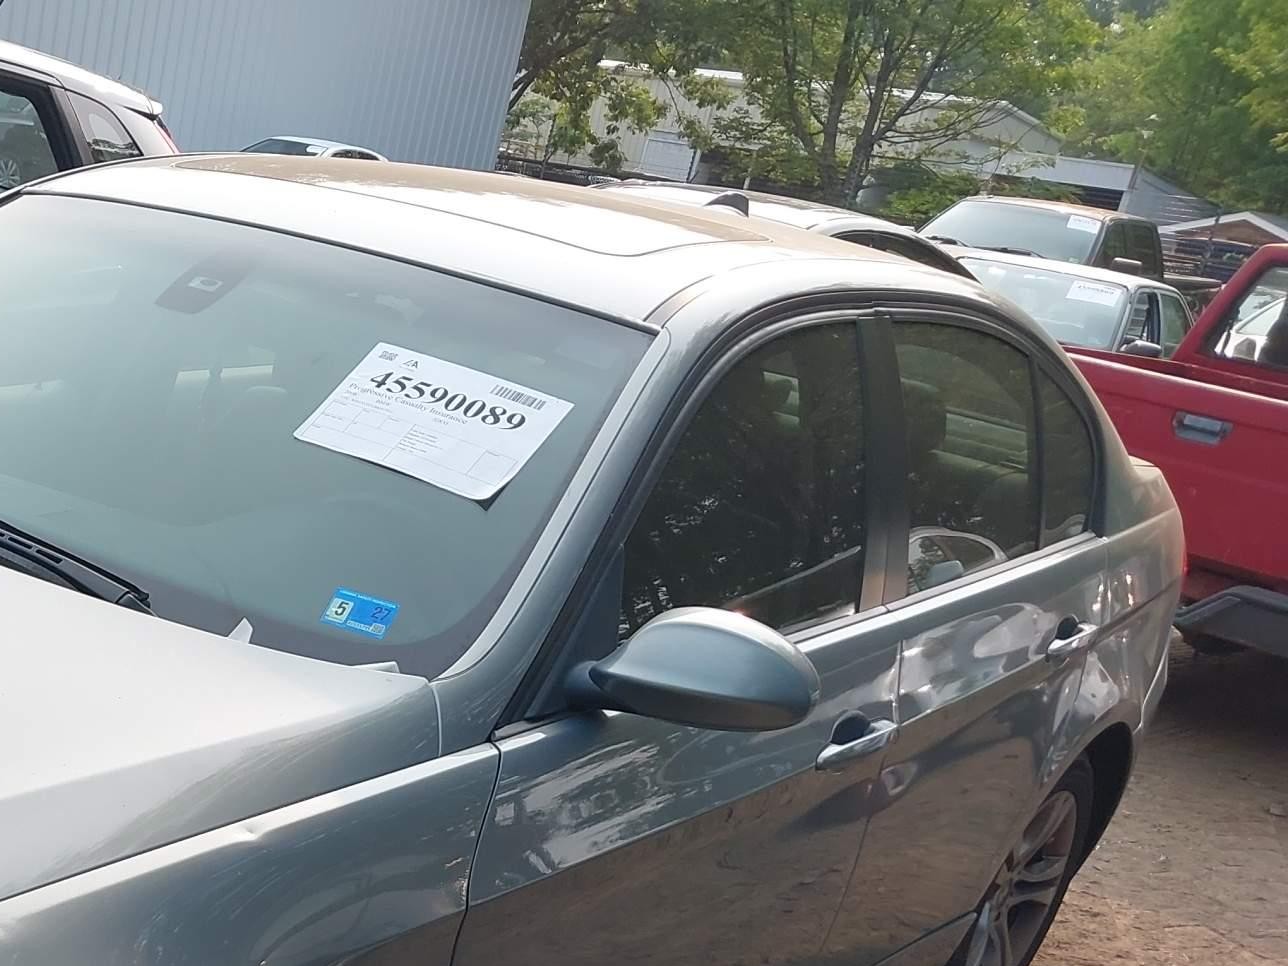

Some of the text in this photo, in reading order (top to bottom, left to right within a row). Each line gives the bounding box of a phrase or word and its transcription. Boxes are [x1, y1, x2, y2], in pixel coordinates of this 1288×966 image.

[349, 382, 393, 401] Progressive
[394, 396, 427, 412] Casualty
[370, 371, 527, 430] 45590089
[334, 600, 392, 621] 5 27
